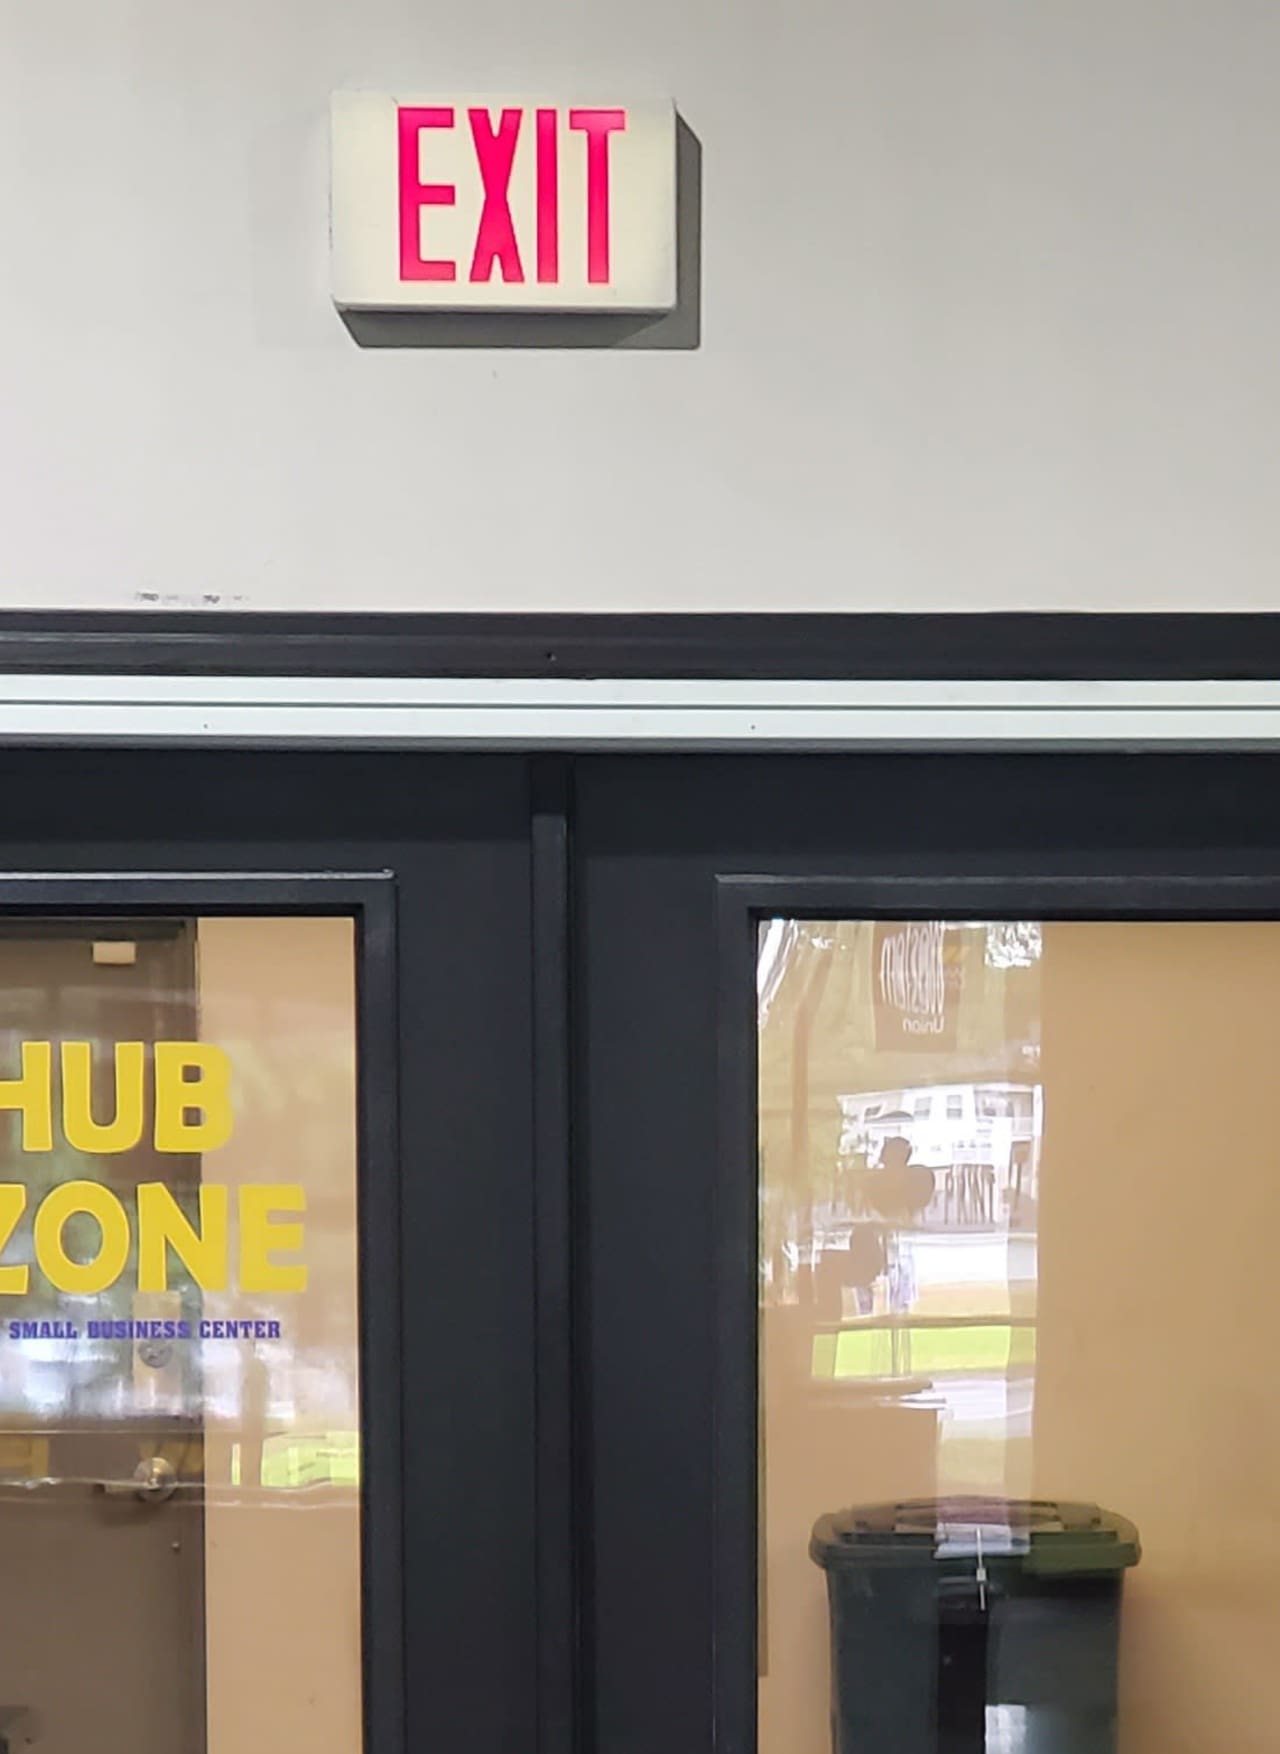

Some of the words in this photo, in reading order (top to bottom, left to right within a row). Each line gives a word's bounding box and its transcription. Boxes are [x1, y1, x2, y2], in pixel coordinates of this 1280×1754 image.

[397, 106, 626, 284] EXIT
[9, 1320, 77, 1340] SMALL
[87, 1320, 190, 1340] BUSINESS
[199, 1320, 281, 1339] CENTER
